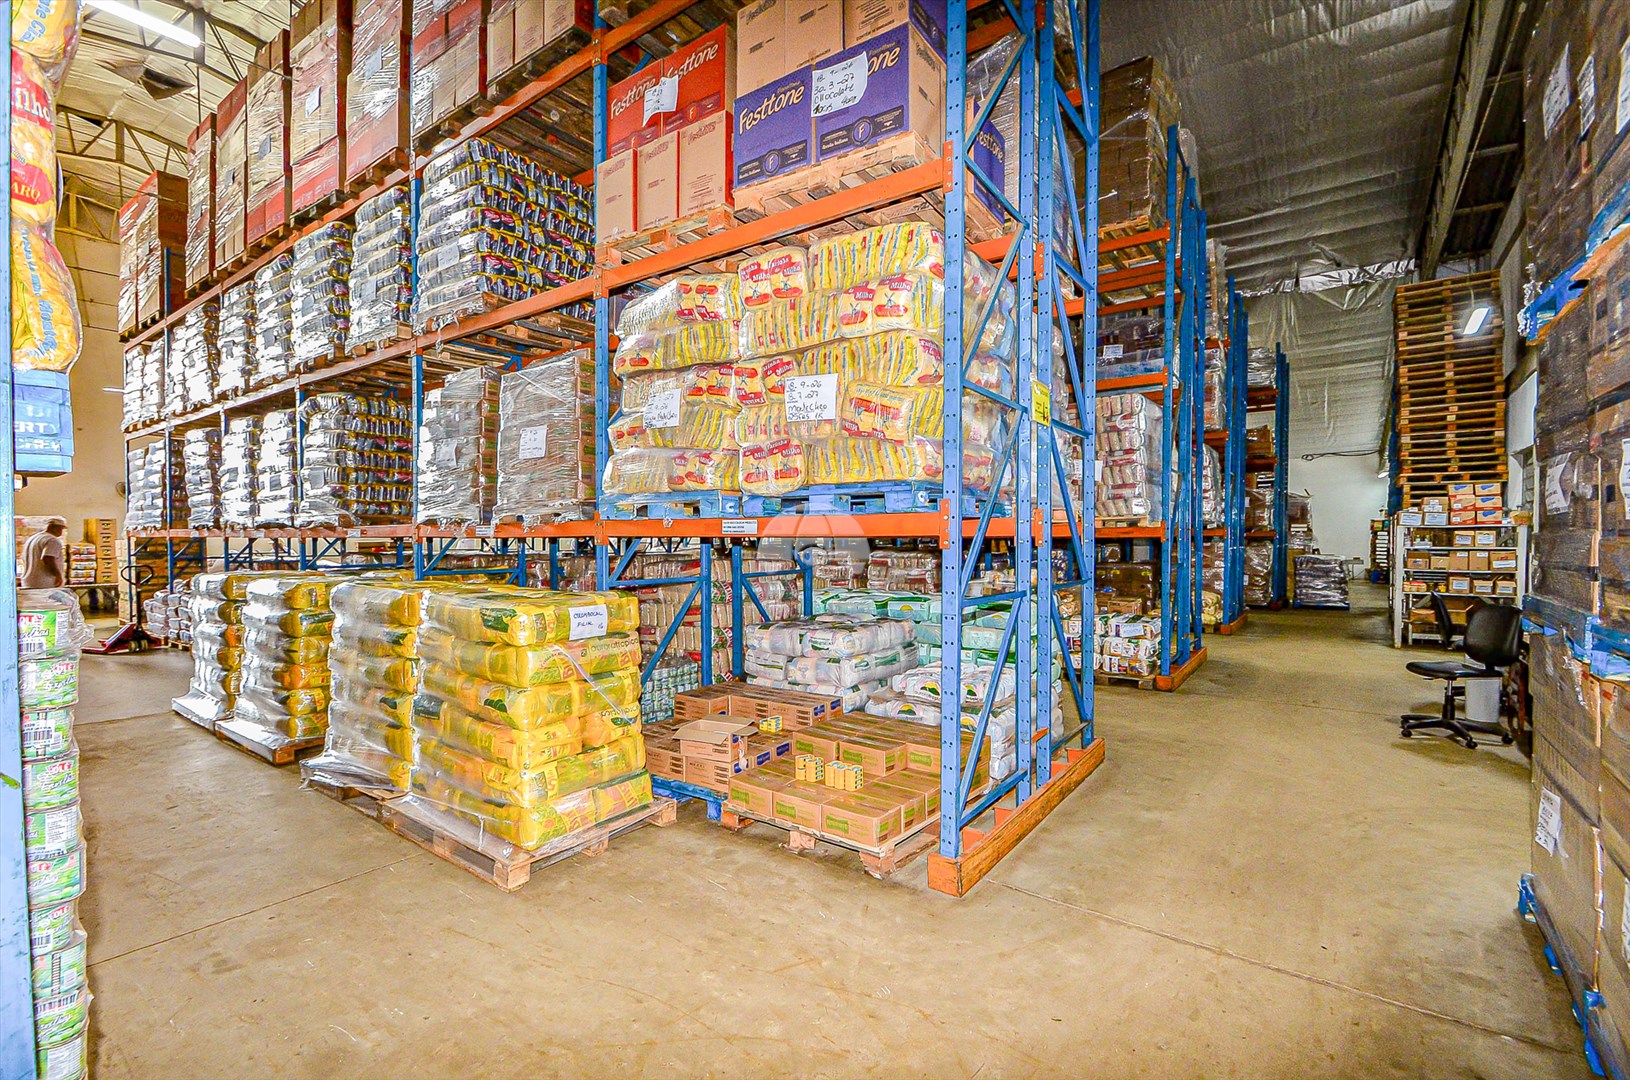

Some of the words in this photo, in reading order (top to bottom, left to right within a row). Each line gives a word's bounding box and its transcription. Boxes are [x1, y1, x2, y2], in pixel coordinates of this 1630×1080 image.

[667, 43, 719, 81] Fsttone
[13, 85, 51, 122] ilho
[611, 78, 656, 120] Festtone
[739, 85, 805, 136] Festtone
[855, 290, 873, 300] Milho
[889, 281, 911, 290] Milho
[775, 363, 794, 376] Milho
[782, 446, 801, 457] Milho
